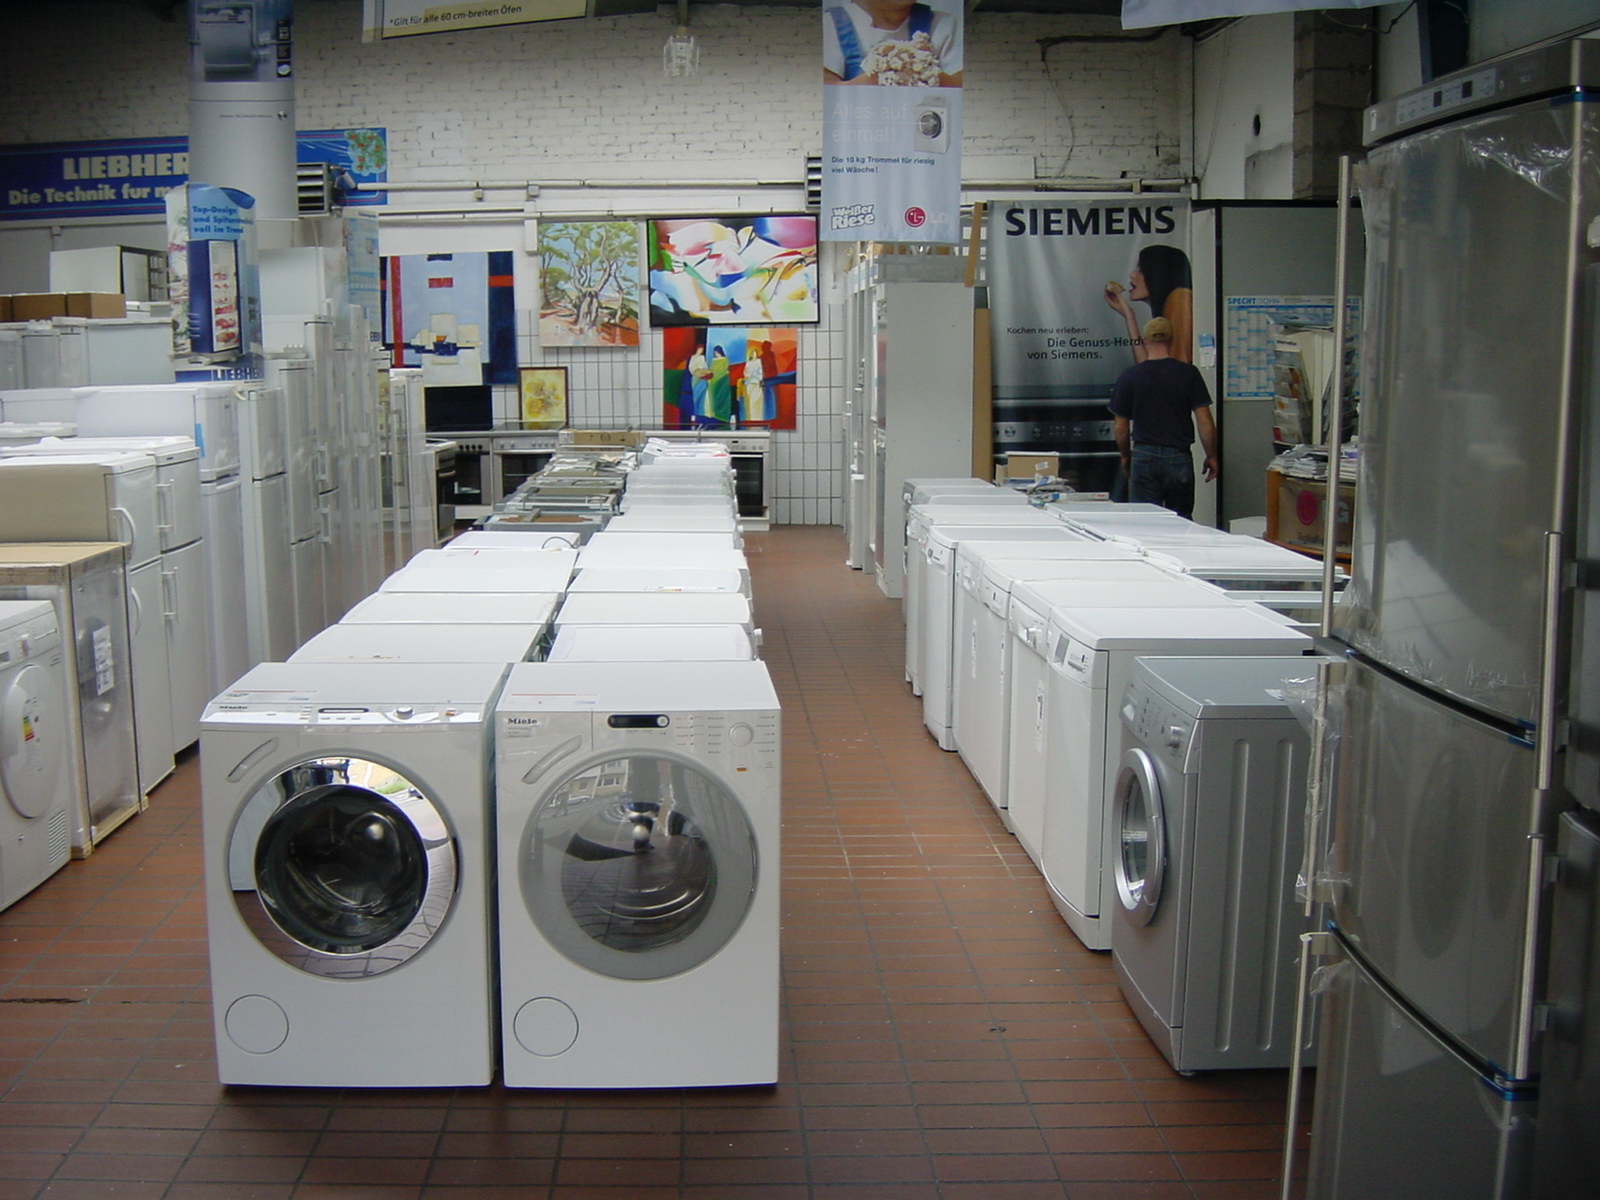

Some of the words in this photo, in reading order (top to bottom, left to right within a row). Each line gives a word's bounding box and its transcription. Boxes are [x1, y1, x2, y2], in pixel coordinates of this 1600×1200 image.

[410, 15, 422, 24] für
[424, 14, 439, 23] alle
[440, 12, 451, 21] 60
[452, 8, 499, 20] cm-breiten
[500, 4, 522, 15] Öfen
[831, 102, 873, 120] Alles
[880, 102, 908, 120] auf
[832, 125, 896, 142] einmal!
[856, 156, 866, 164] kg
[867, 156, 900, 164] Trommel
[914, 158, 935, 166] riesig
[8, 189, 41, 205] Die
[43, 184, 117, 203] Technik
[192, 206, 237, 215] Top-Design
[832, 204, 874, 216] Weißer
[831, 213, 875, 230] Riese
[1005, 206, 1176, 236] SIEMENS
[1007, 326, 1036, 334] Kochen
[1047, 337, 1066, 348] Die
[1027, 352, 1048, 360] von
[1051, 349, 1103, 360] Siemens.
